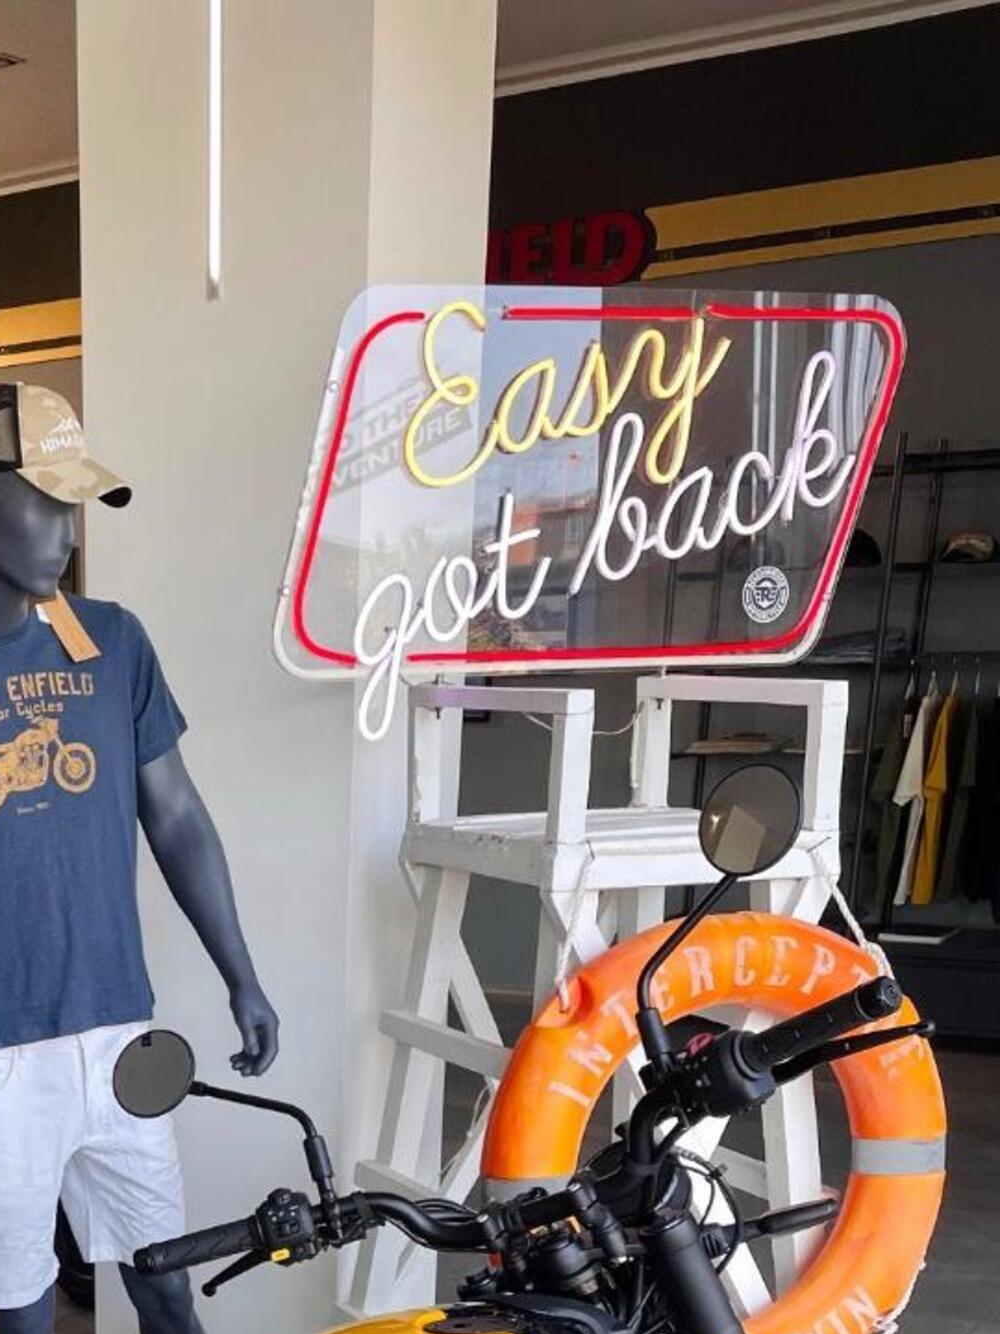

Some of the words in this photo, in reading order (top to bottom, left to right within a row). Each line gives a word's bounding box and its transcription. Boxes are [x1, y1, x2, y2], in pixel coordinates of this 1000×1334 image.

[404, 300, 732, 487] Easy
[353, 493, 553, 741] got
[568, 350, 856, 595] back
[6, 671, 95, 701] ENFIELD
[15, 700, 65, 720] Cycles
